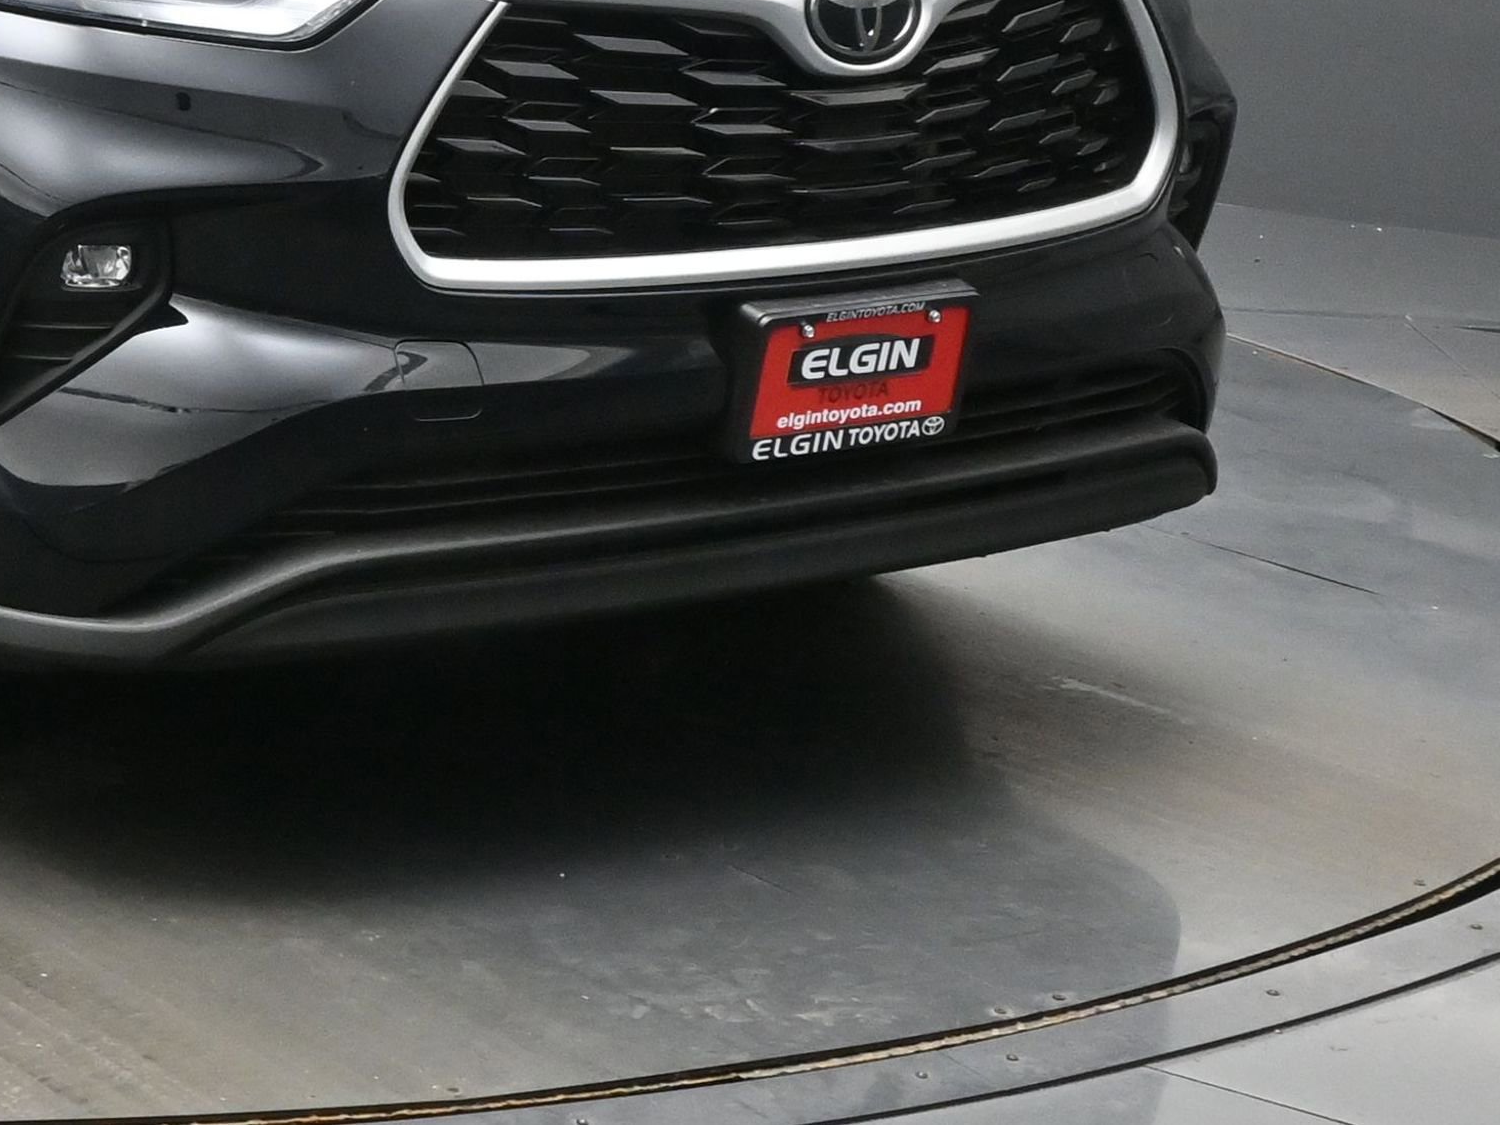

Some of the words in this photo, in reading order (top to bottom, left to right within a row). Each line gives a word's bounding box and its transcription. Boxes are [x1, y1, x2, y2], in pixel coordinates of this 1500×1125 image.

[826, 301, 927, 323] ELGINTOYOTA.COM
[801, 337, 921, 380] ELGIN
[817, 380, 889, 403] TOYOTA
[777, 399, 922, 430] elgintoyota.com
[752, 429, 844, 461] ELGIN
[848, 420, 921, 446] TOYOTA
